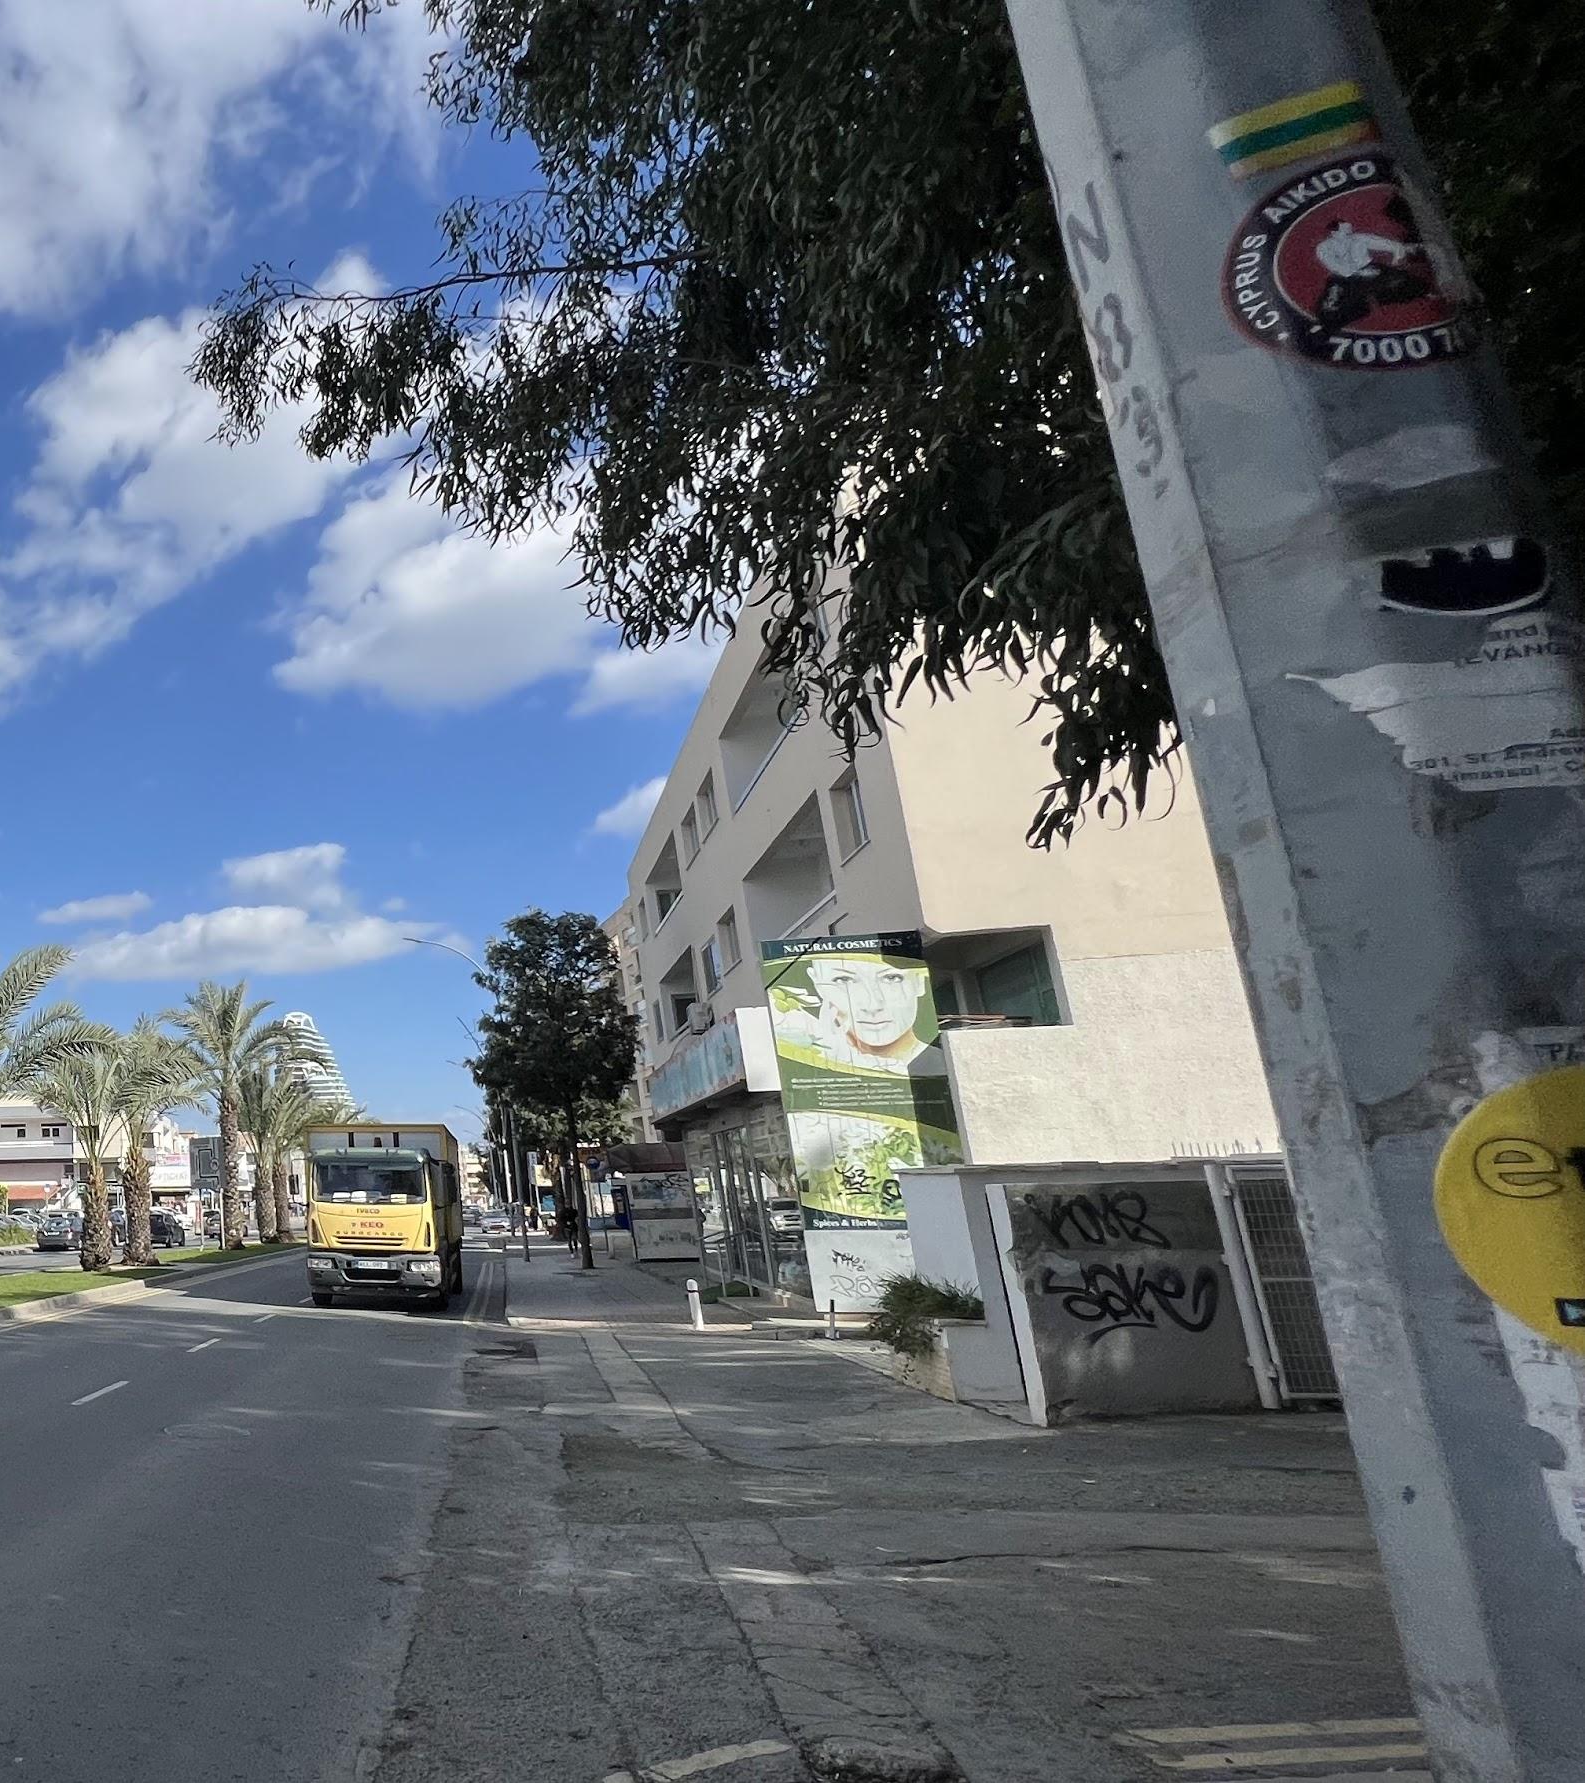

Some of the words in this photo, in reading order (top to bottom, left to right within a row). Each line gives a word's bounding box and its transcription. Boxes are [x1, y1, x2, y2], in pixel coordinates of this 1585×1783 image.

[1234, 233, 1280, 330] CYPRUS
[1262, 160, 1376, 225] AIKIDO
[783, 941, 836, 954] NATURAL
[836, 938, 903, 950] COSMETICS
[360, 1221, 384, 1229] KEO
